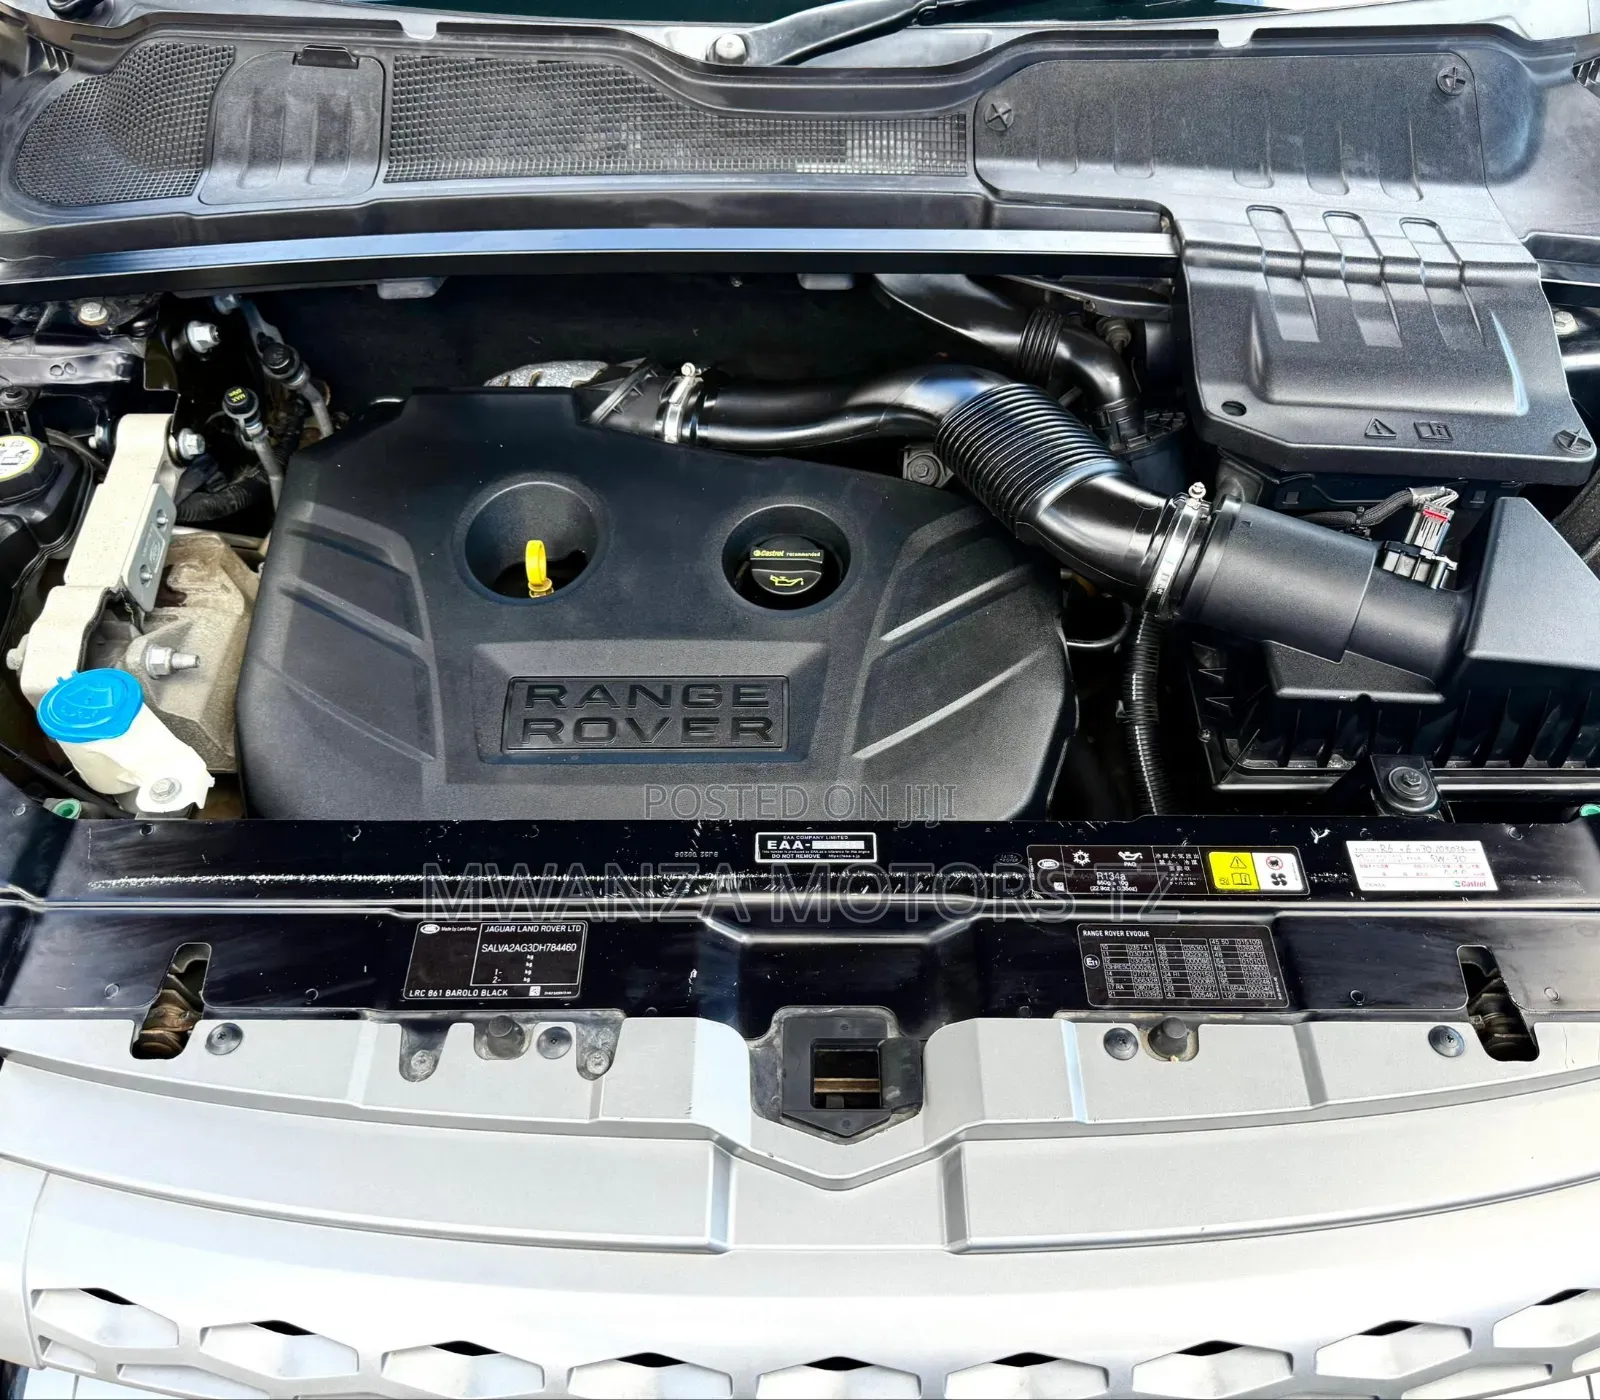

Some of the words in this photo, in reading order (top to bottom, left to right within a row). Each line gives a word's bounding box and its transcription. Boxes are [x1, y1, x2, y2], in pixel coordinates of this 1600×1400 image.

[525, 683, 770, 709] RANGE
[521, 716, 775, 745] ROVER
[1096, 871, 1127, 880] R134a
[481, 943, 577, 953] SALVA2AG3DH784460
[409, 989, 426, 997] LRC
[427, 989, 442, 997] 861
[445, 989, 479, 997] BAROLO
[480, 989, 509, 997] BLACK
